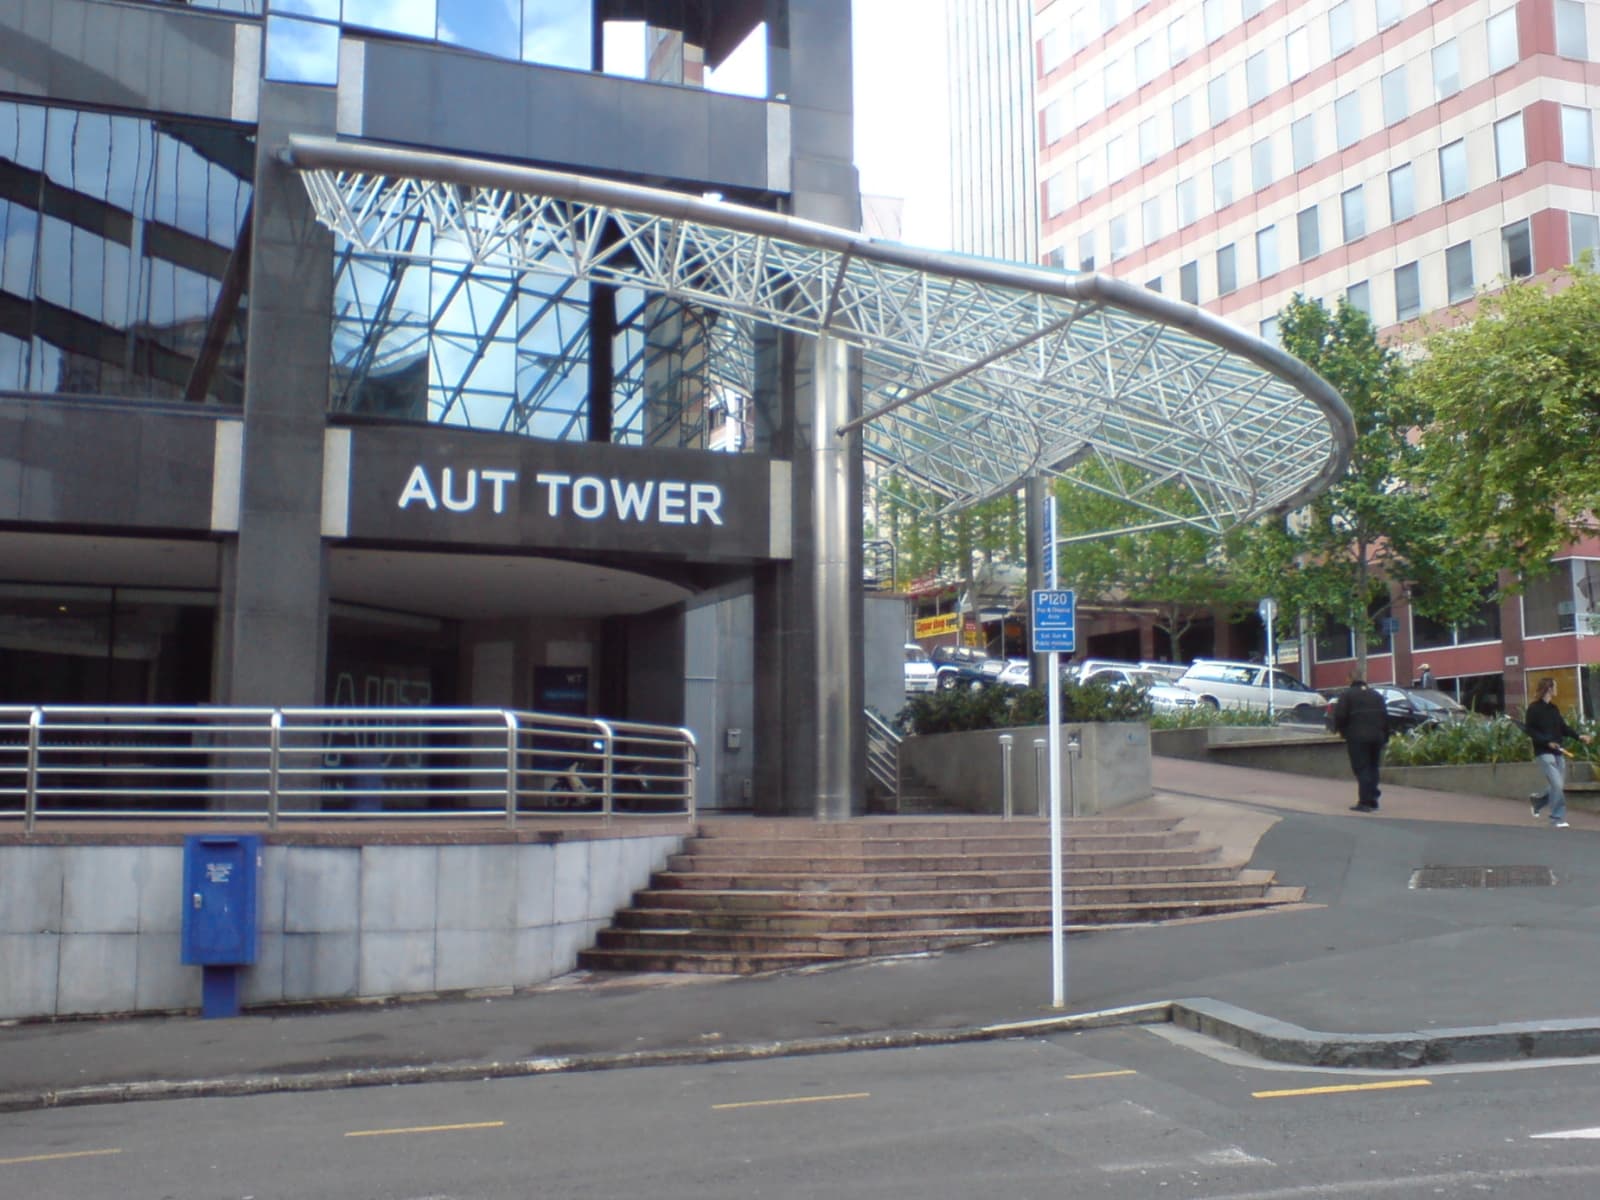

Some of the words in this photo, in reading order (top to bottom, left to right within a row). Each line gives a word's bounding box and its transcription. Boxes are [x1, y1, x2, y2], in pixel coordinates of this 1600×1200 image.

[398, 465, 516, 513] AUT
[536, 473, 723, 525] TOWER
[1039, 593, 1067, 605] P120
